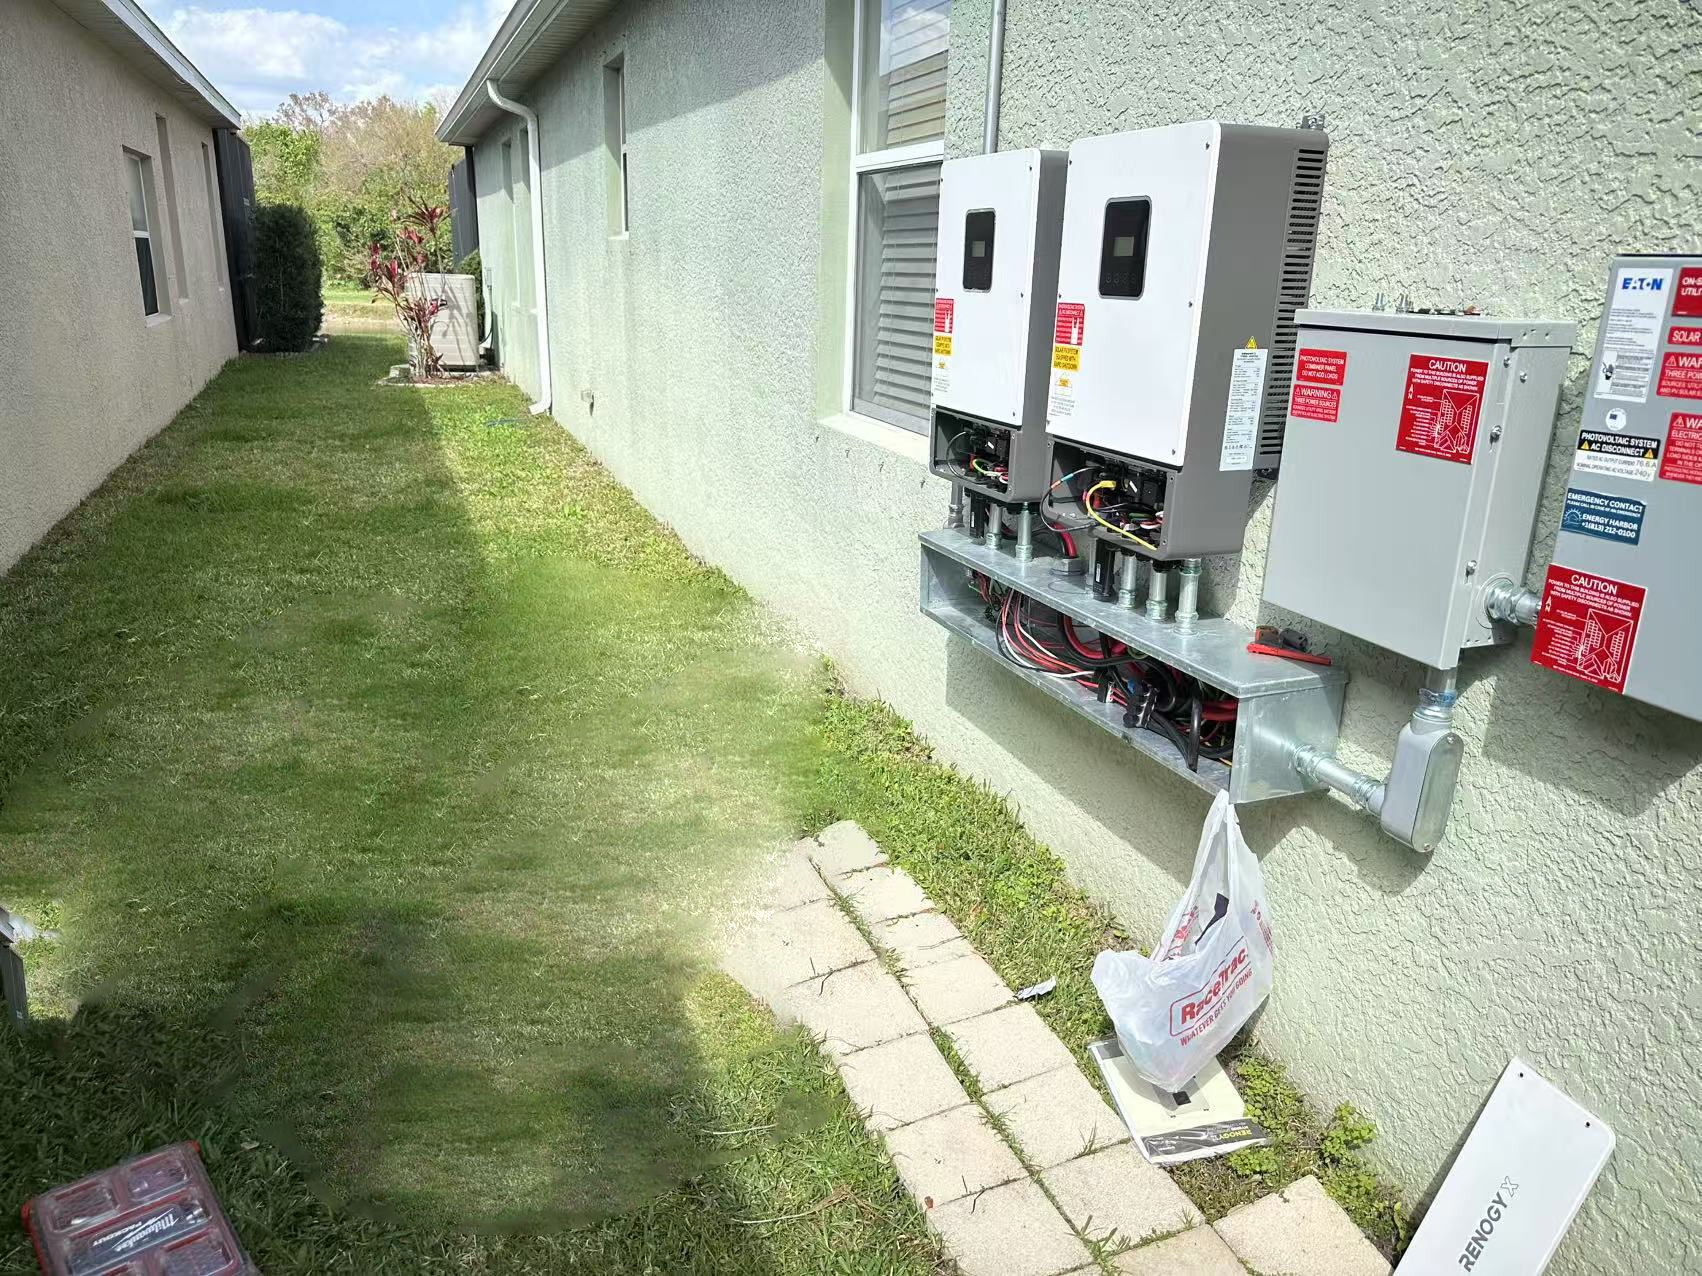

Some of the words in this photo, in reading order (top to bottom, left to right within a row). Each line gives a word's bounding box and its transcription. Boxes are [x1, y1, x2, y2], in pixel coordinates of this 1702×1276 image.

[1672, 330, 1701, 342] SOLAR
[1429, 360, 1466, 372] CAUTION
[1666, 369, 1686, 378] THREE
[1301, 388, 1331, 398] WARNING
[1581, 432, 1630, 444] PHOTOVOLTAIC
[1630, 438, 1658, 448] SYSTEM
[1590, 442, 1600, 450] AC
[1602, 444, 1644, 456] DISCONNECT
[1568, 492, 1609, 506] EMERGENCY
[1610, 501, 1643, 512] CONTACT
[1617, 509, 1641, 517] EMERGENCY
[1582, 513, 1608, 525] ENERGY
[1609, 518, 1638, 530] HARBOR
[1604, 526, 1635, 538] 212-0100
[1571, 574, 1617, 594] CAUTION
[1548, 579, 1563, 587] POWER
[1580, 587, 1599, 596] BUILDING
[1618, 597, 1639, 607] SUPPLIED
[1561, 593, 1577, 602] SAFETY
[1567, 589, 1585, 598] MULTIPLE
[1586, 594, 1606, 604] SOURCES
[1614, 602, 1630, 611] POWER
[1182, 946, 1248, 1024] RaceTrac
[1180, 1014, 1214, 1046] WHATEVER
[1235, 968, 1253, 990] GOING
[1219, 1129, 1252, 1140] RENOGY
[1458, 1192, 1508, 1272] RENOGY
[1500, 1176, 1519, 1198] X
[92, 1221, 142, 1246] PACKOUT
[114, 1213, 179, 1252] Milwaukee
